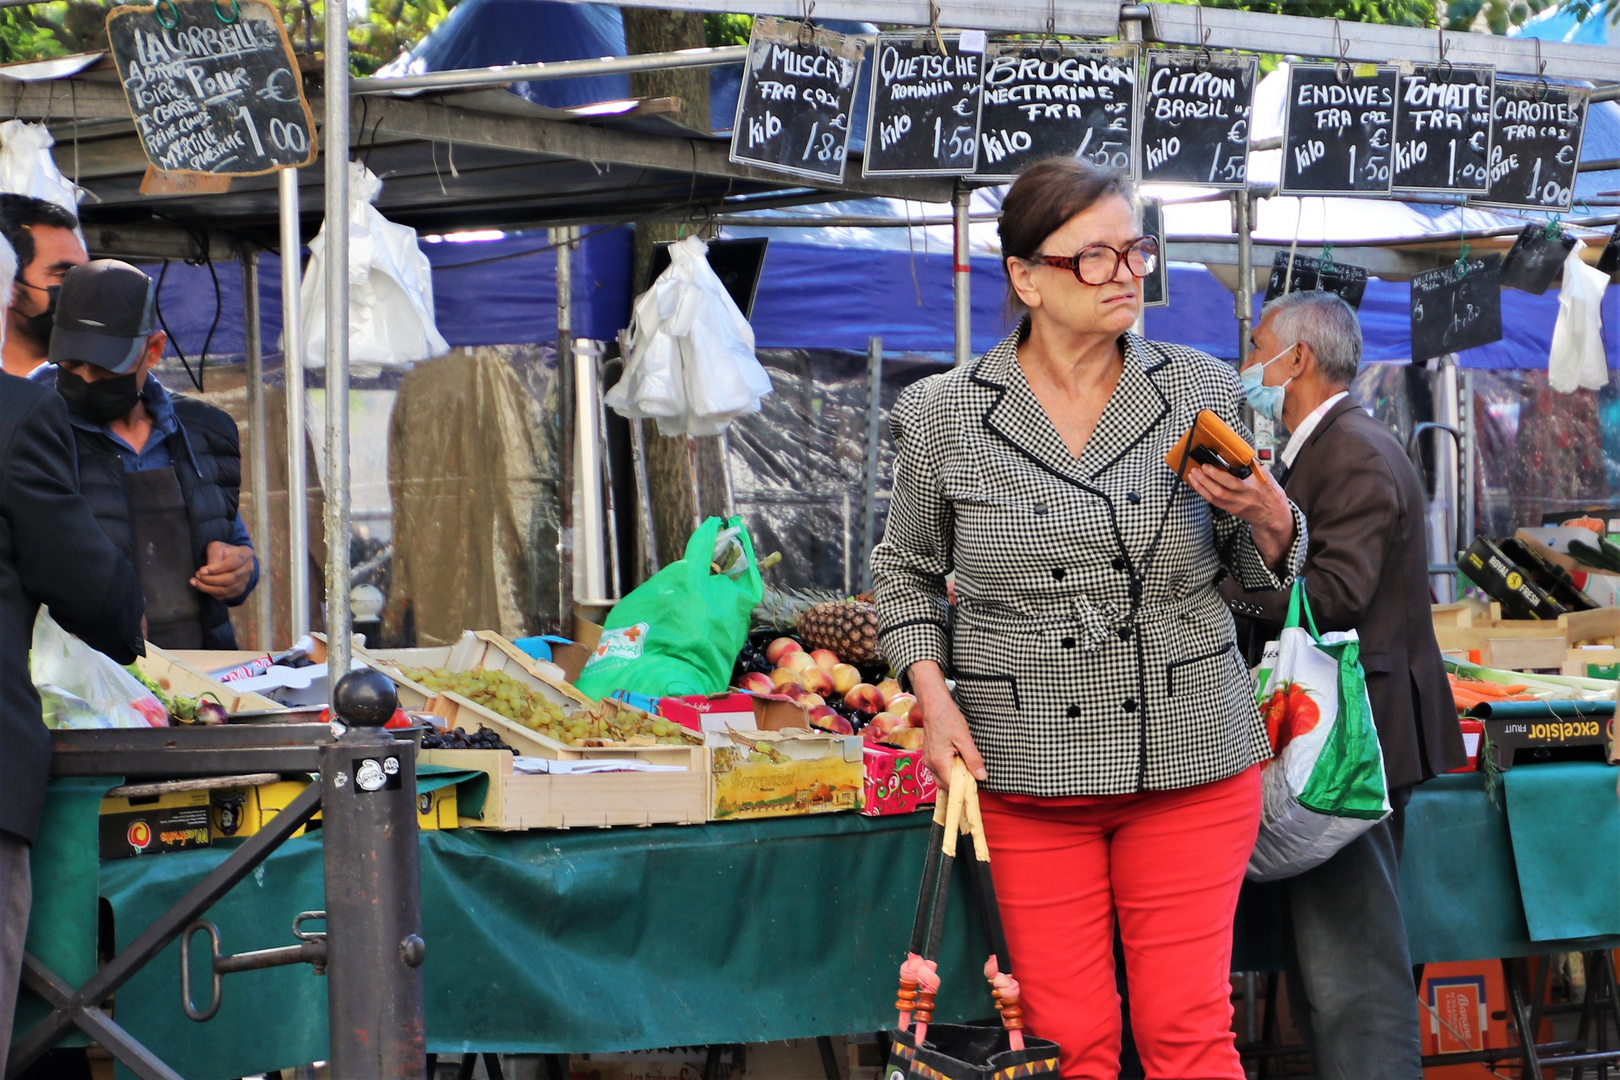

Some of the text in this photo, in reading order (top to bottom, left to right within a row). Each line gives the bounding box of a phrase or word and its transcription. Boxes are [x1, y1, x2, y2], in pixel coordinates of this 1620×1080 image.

[881, 46, 978, 87] QUETSCHE
[985, 56, 1133, 84] BRUGNON
[758, 81, 797, 100] FRA
[1151, 67, 1236, 99] CITRON
[1403, 76, 1490, 109] TOMATE
[1297, 84, 1393, 106] ENDIVES
[951, 97, 974, 117] €
[1018, 103, 1082, 121] FRA
[1154, 98, 1229, 120] BRAZIL
[1314, 109, 1352, 129] FRA
[1408, 108, 1462, 131] FRA
[1227, 119, 1247, 142] €
[1369, 127, 1390, 149] €
[1468, 130, 1486, 150] €
[1502, 124, 1537, 141] FRA
[1555, 144, 1575, 165] €
[1488, 555, 1510, 578] ROYAL
[1518, 583, 1541, 608] FRESH
[1504, 720, 1600, 742] excelsior FRUIT
[1456, 993, 1472, 1040] Banane
